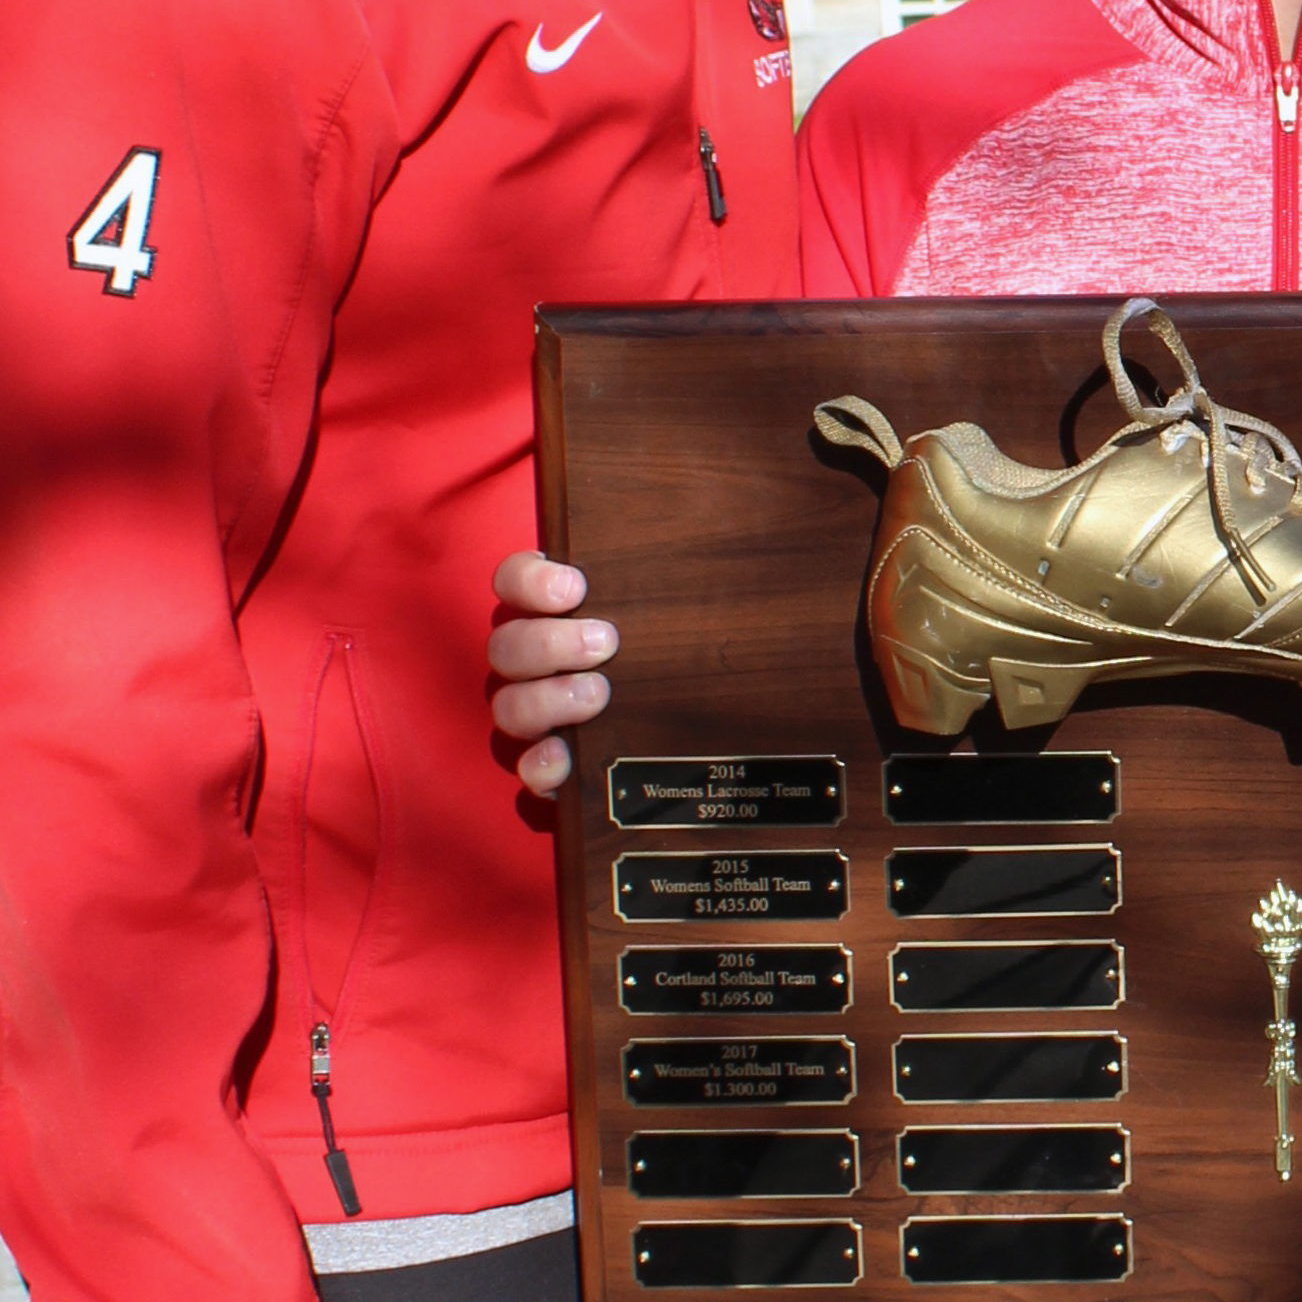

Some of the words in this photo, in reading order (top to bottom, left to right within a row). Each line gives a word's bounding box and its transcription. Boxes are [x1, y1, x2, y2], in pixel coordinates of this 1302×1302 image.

[66, 145, 162, 299] 4
[708, 764, 746, 779] 2014
[643, 783, 704, 798] Womens
[707, 783, 769, 798] Lacrosse
[772, 783, 812, 797] Team
[698, 804, 758, 819] $920.00
[712, 859, 749, 874] 2015
[651, 879, 711, 893] Womens
[714, 877, 769, 892] Softball
[772, 877, 812, 891] Team
[695, 897, 769, 915] $1,435.00
[718, 953, 756, 968] 2016
[655, 971, 716, 986] Cortland
[720, 970, 775, 985] Softball
[778, 971, 817, 985] Team
[701, 990, 774, 1007] $1,695.00
[721, 1044, 758, 1059] 2017
[654, 1063, 722, 1078] Women's
[725, 1061, 782, 1077] Softball
[785, 1061, 825, 1076] Team
